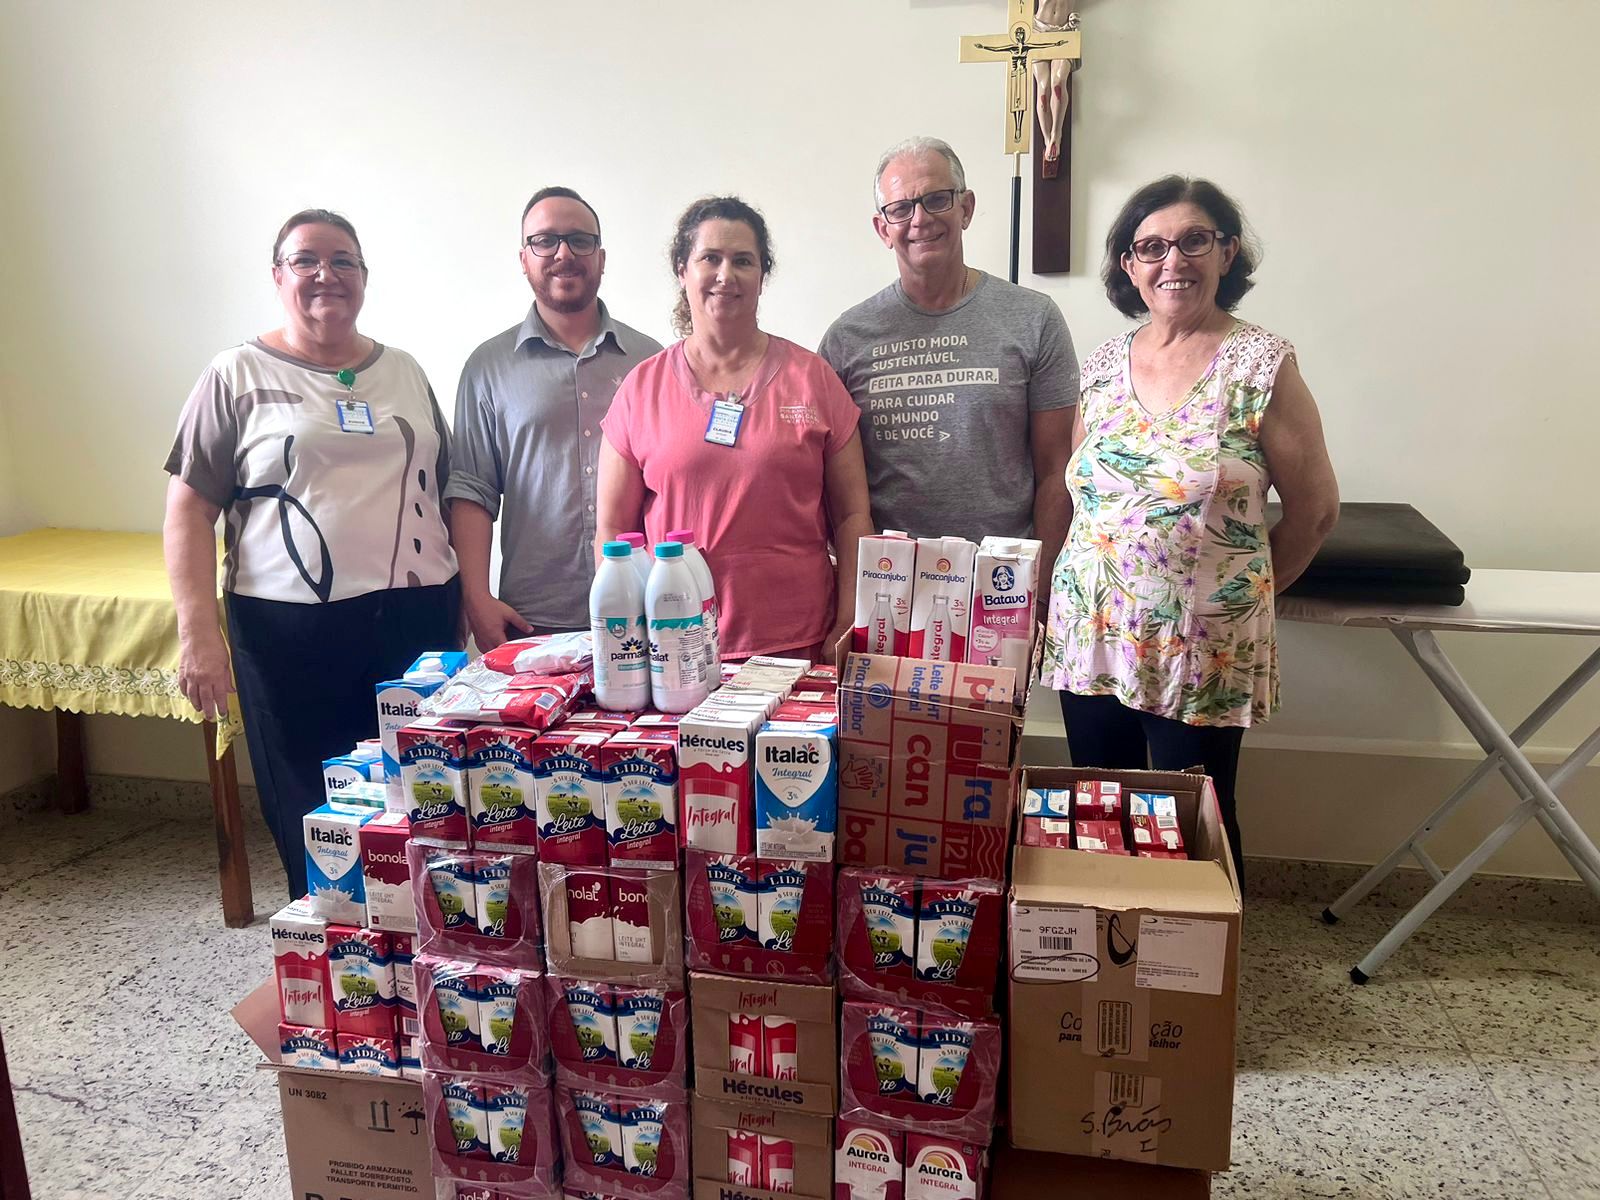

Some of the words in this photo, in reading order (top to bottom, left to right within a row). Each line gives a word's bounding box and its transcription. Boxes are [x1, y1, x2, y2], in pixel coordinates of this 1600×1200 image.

[872, 346, 887, 358] EU
[891, 338, 927, 353] VISTO
[930, 335, 968, 348] MODA
[871, 351, 960, 372] SUSTENTÁVEL,
[871, 376, 903, 391] FEITA
[908, 373, 943, 387] PARA
[947, 370, 998, 384] DURAR,
[870, 397, 903, 410] PARA
[907, 393, 955, 406] CUIDAR
[873, 414, 887, 426] DO
[891, 410, 939, 424] MUNDO
[876, 430, 882, 440] E
[884, 428, 898, 440] DE
[901, 425, 934, 439] VOCÊ
[862, 570, 907, 582] Piracanjuba
[920, 571, 965, 584] Piracanjuba
[984, 594, 1026, 606] Batavo
[983, 613, 1018, 625] Integral
[930, 664, 945, 690] Leite
[908, 666, 927, 711] integral
[381, 702, 421, 717] Italac
[680, 734, 745, 753] Hércules
[409, 748, 449, 760] LIDER
[479, 750, 520, 763] LIDER
[765, 746, 820, 764] Italac
[545, 759, 589, 772] LIDER
[614, 764, 659, 777] LIDER
[904, 734, 931, 807] can
[772, 768, 813, 779] Integral
[787, 792, 799, 800] 3%
[963, 779, 993, 820] ra
[417, 800, 448, 820] Leite
[483, 802, 517, 822] Leite
[687, 802, 737, 829] Integral
[424, 818, 445, 829] integral
[489, 822, 513, 833] integral
[550, 813, 585, 833] Leite
[620, 819, 656, 839] Leite
[311, 827, 352, 846] Italac
[556, 833, 580, 844] integral
[844, 816, 876, 863] ba
[317, 845, 348, 857] Integral
[626, 838, 651, 850] integral
[896, 828, 937, 866] ju
[368, 849, 409, 864] bonola
[708, 870, 741, 884] IDER
[770, 876, 804, 885] LIDE
[568, 882, 599, 902] nolat
[863, 893, 900, 907] IDER
[271, 928, 325, 944] Hércules
[720, 928, 738, 939] ite
[338, 946, 374, 957] LIDER
[875, 952, 894, 964] ite
[285, 985, 322, 1007] Integral
[344, 991, 373, 1008] Leite
[568, 993, 600, 1006] IDER
[738, 989, 777, 1009] Integral
[629, 1000, 660, 1009] LIDE
[448, 1031, 462, 1040] ite
[935, 1033, 970, 1045] LIDE
[1058, 1032, 1082, 1043] para
[290, 1040, 325, 1051] LIDER
[583, 1047, 598, 1057] ite
[348, 1050, 385, 1061] LIDER
[288, 1087, 303, 1097] UN
[305, 1089, 327, 1100] 3082
[443, 1087, 473, 1101] IDER
[723, 1076, 804, 1105] Hércules
[738, 1111, 775, 1128] Integral
[847, 1146, 890, 1163] Aurora
[329, 1160, 364, 1170] PROIBIDO
[366, 1164, 413, 1176] ARMAZENAR
[331, 1168, 358, 1177] PALLET
[848, 1160, 887, 1174] INTEGRAL
[918, 1163, 963, 1181] Aurora
[326, 1175, 376, 1187] TRANSPORTE
[920, 1177, 960, 1192] INTEGRAL
